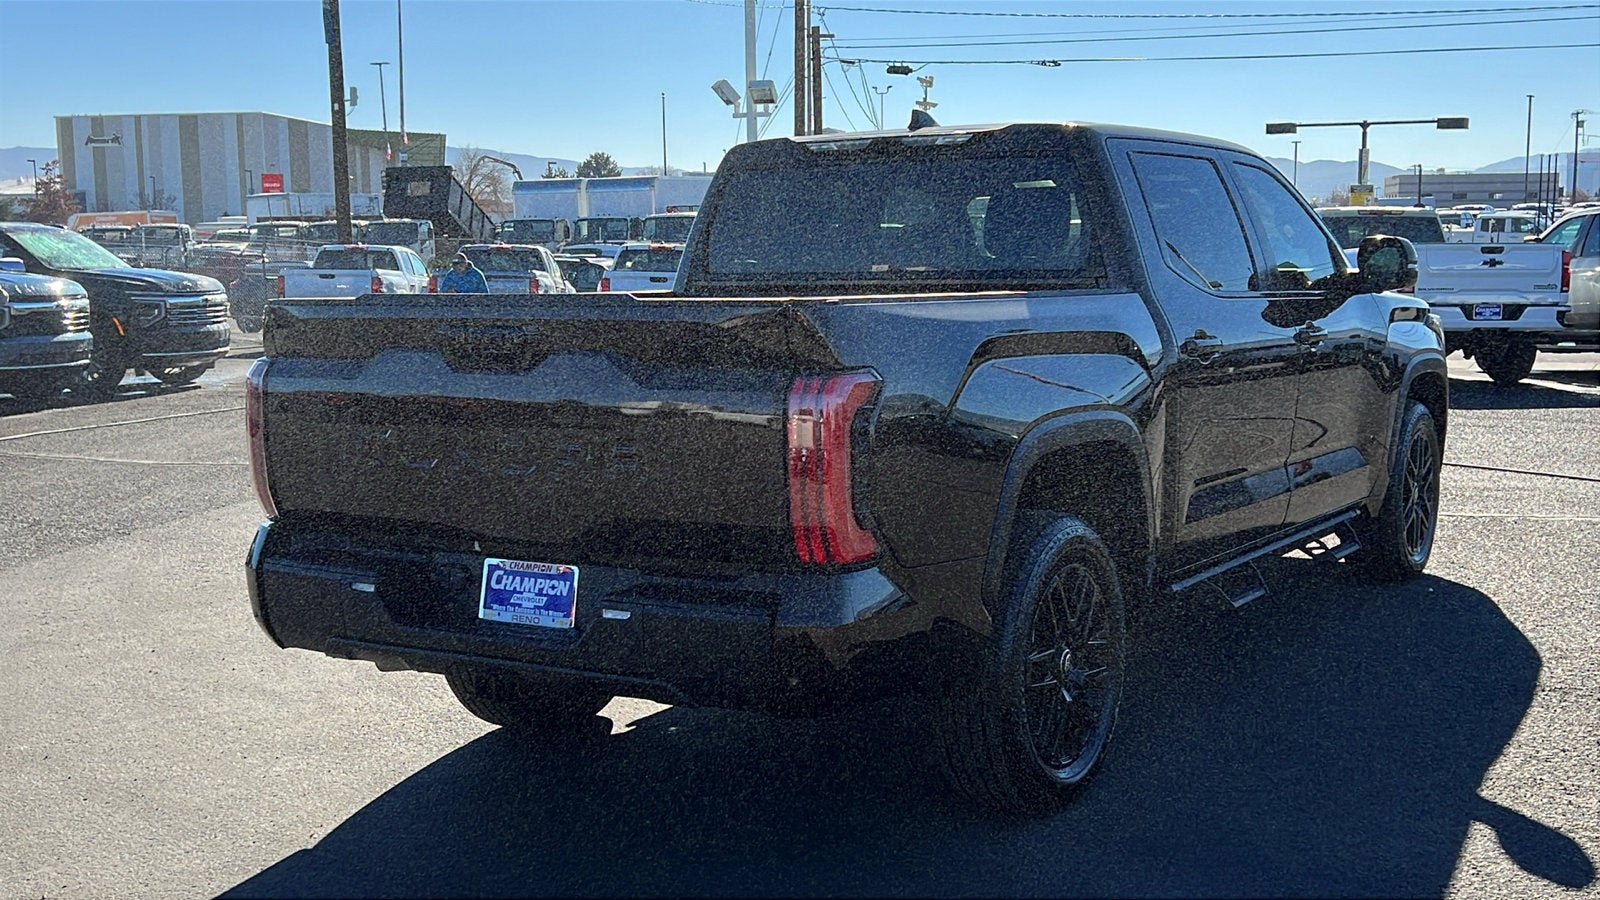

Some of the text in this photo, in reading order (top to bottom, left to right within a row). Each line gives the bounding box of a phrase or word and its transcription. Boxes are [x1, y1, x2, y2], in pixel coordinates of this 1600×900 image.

[509, 561, 553, 573] CHAMPION
[490, 570, 571, 597] CHAMPION
[512, 595, 545, 605] CHEVROLET
[511, 614, 541, 625] RENO
